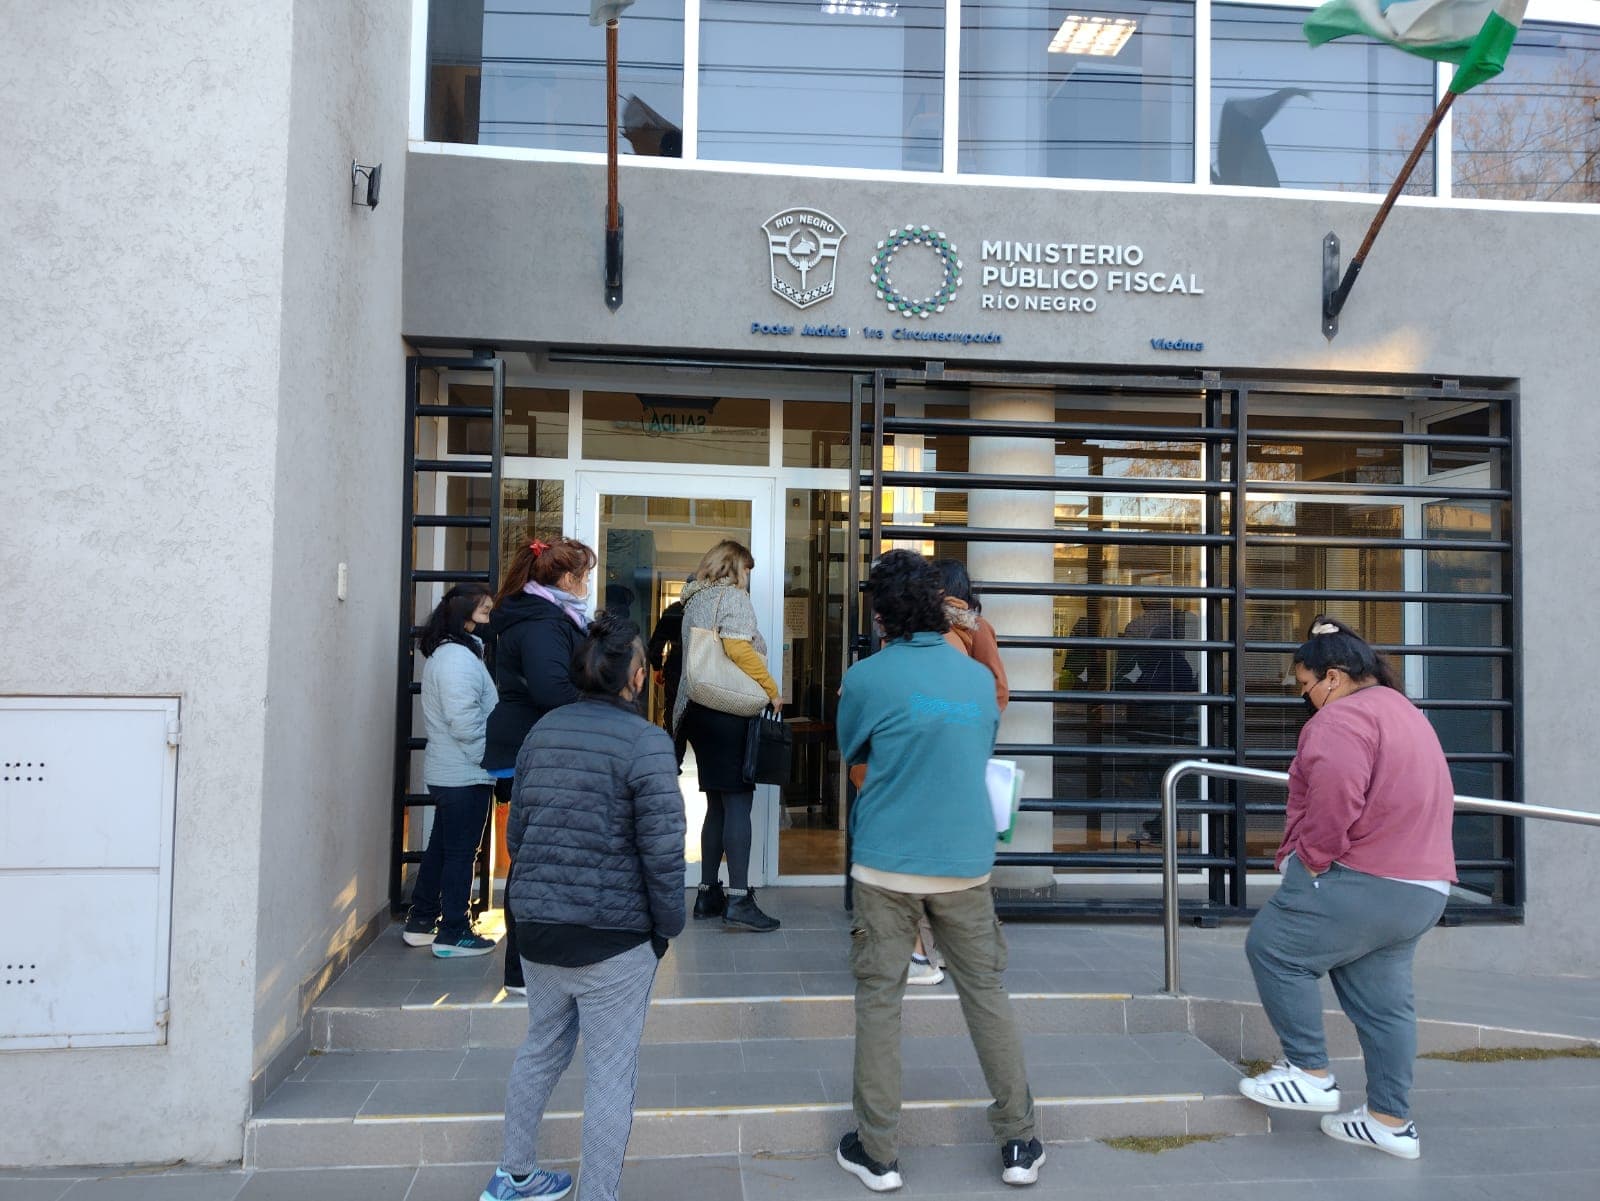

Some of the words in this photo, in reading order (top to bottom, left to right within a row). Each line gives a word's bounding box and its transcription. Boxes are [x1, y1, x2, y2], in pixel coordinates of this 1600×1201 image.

[799, 214, 835, 233] NEGRO
[981, 239, 1144, 266] MINISTERIO
[982, 261, 1099, 290] PÚBLICO
[1107, 271, 1204, 294] FISCAL
[981, 290, 1020, 309] RÍO
[1025, 295, 1097, 312] NEGRO
[751, 322, 794, 335] Poder
[801, 324, 851, 337] Judicial
[1150, 338, 1204, 352] Viedma
